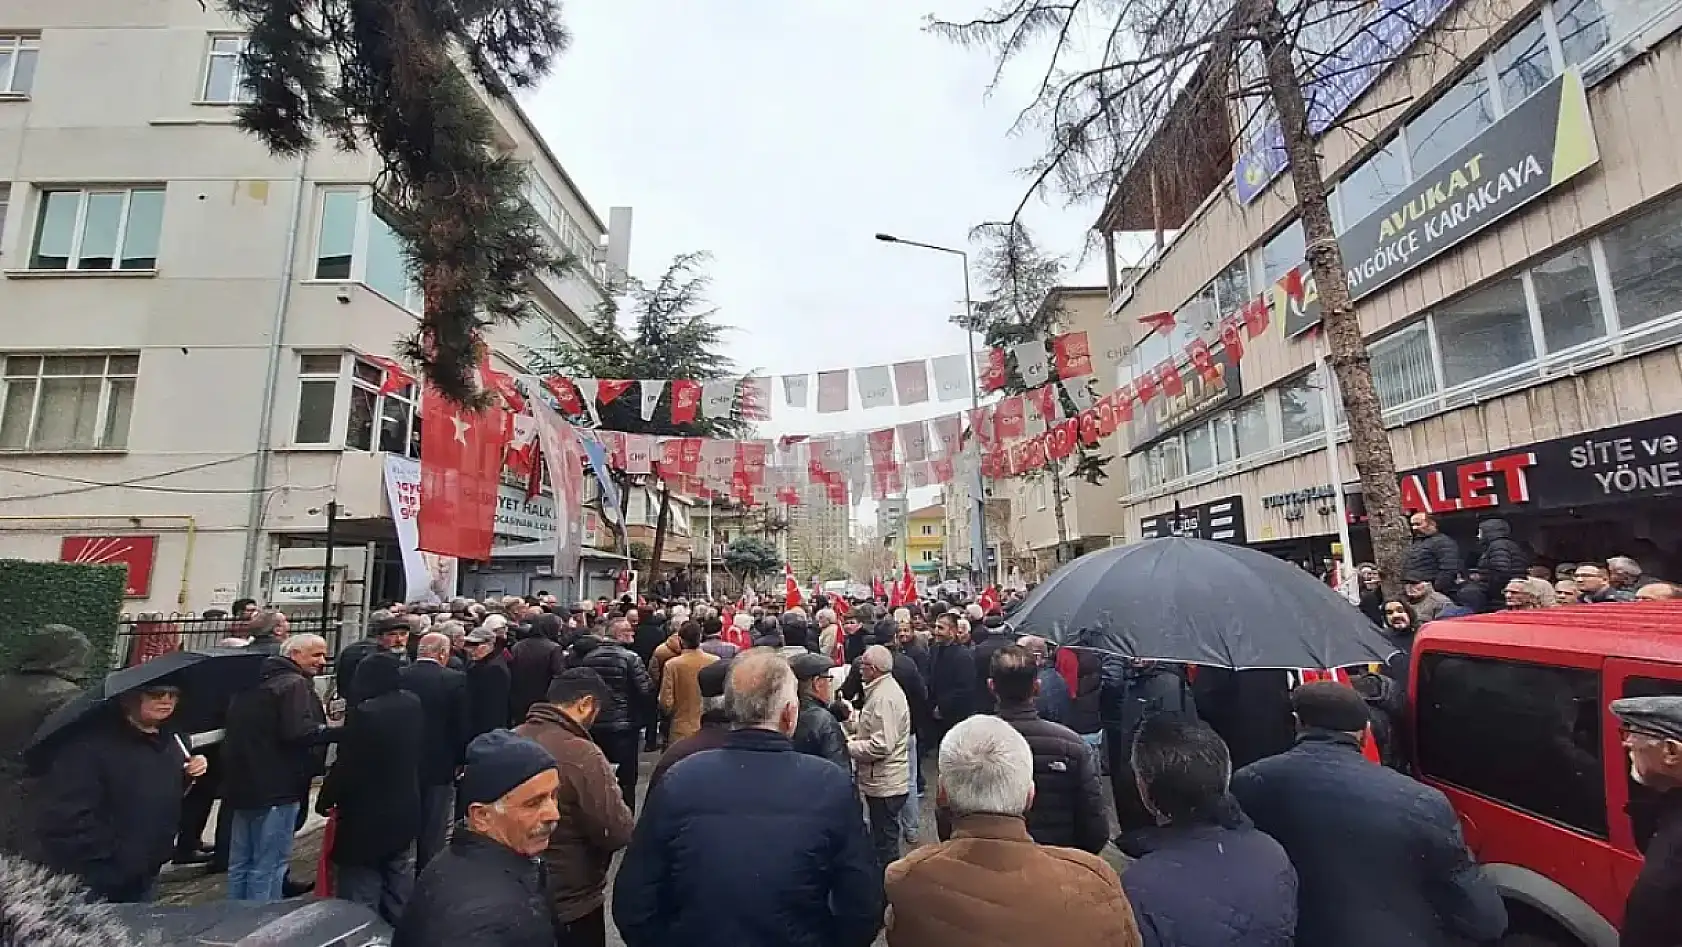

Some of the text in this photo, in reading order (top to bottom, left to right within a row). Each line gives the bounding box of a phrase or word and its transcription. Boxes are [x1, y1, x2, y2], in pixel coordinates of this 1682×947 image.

[1379, 152, 1484, 243] AVUKAT
[1424, 153, 1544, 244] KARAKAYA
[630, 452, 646, 462] CHP
[714, 457, 731, 465] CHP
[1570, 435, 1679, 469] SİTE ve
[1400, 452, 1537, 514] ALET
[1594, 461, 1682, 495] YÖNE
